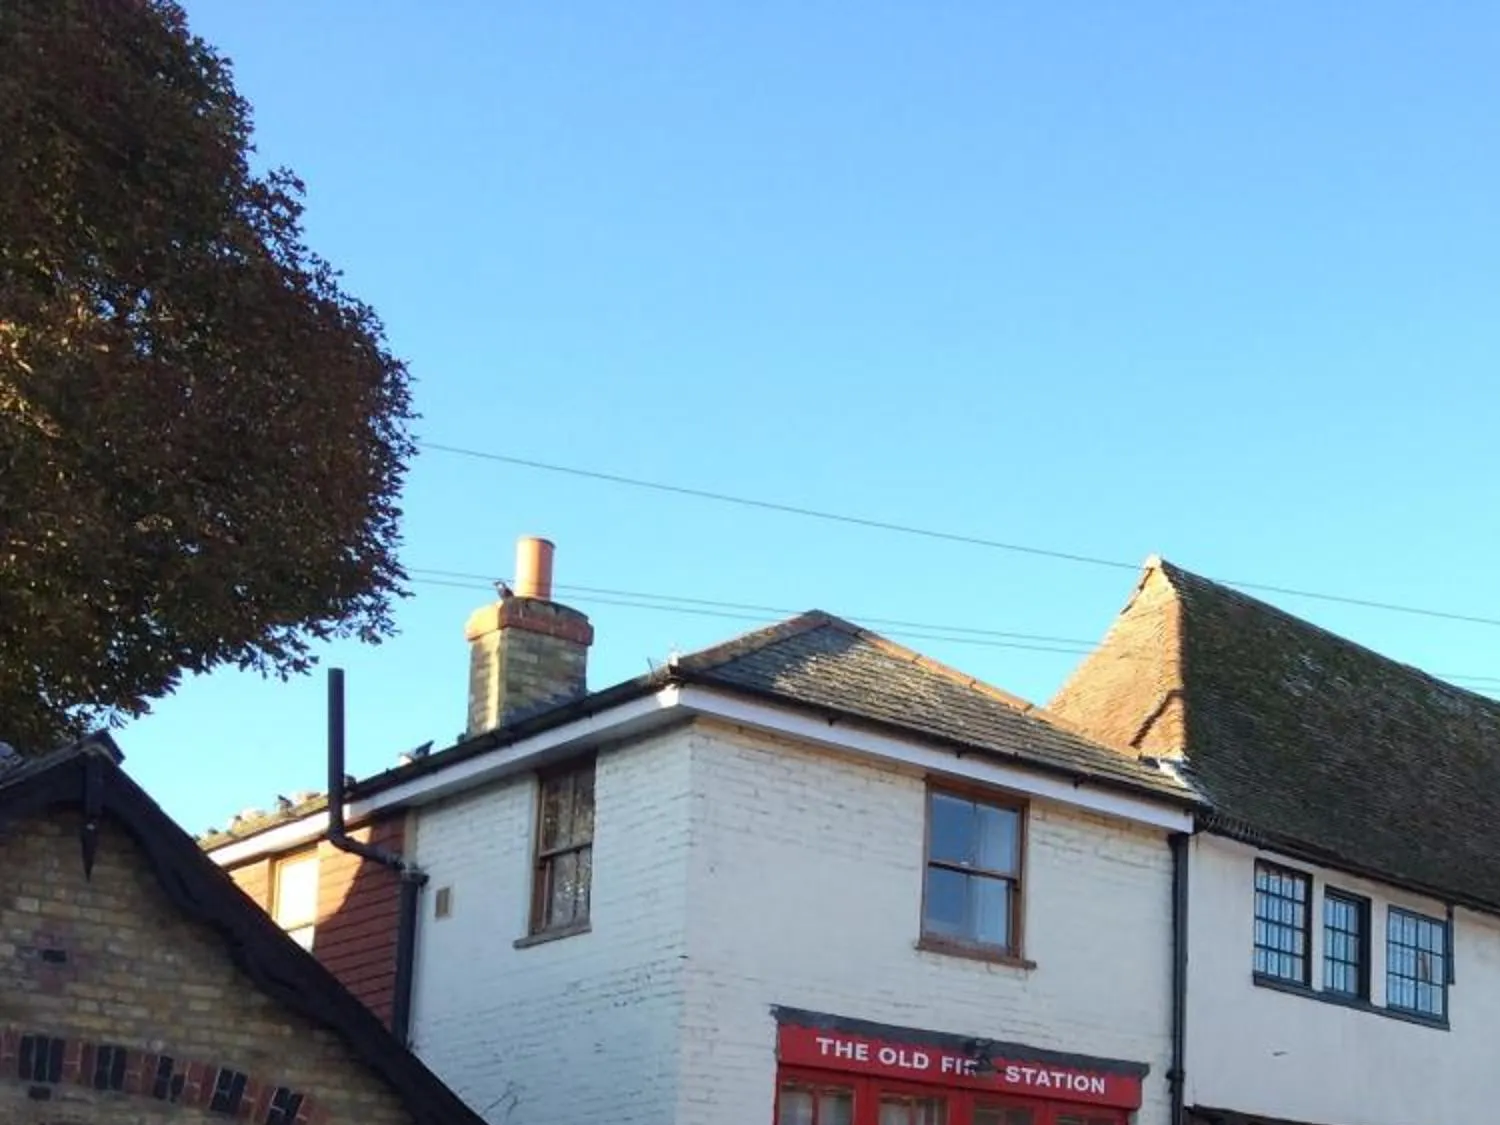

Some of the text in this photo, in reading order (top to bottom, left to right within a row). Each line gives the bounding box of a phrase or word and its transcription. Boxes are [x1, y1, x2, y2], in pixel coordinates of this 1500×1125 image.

[815, 1037, 1106, 1095] THE OLD FIR STATION
